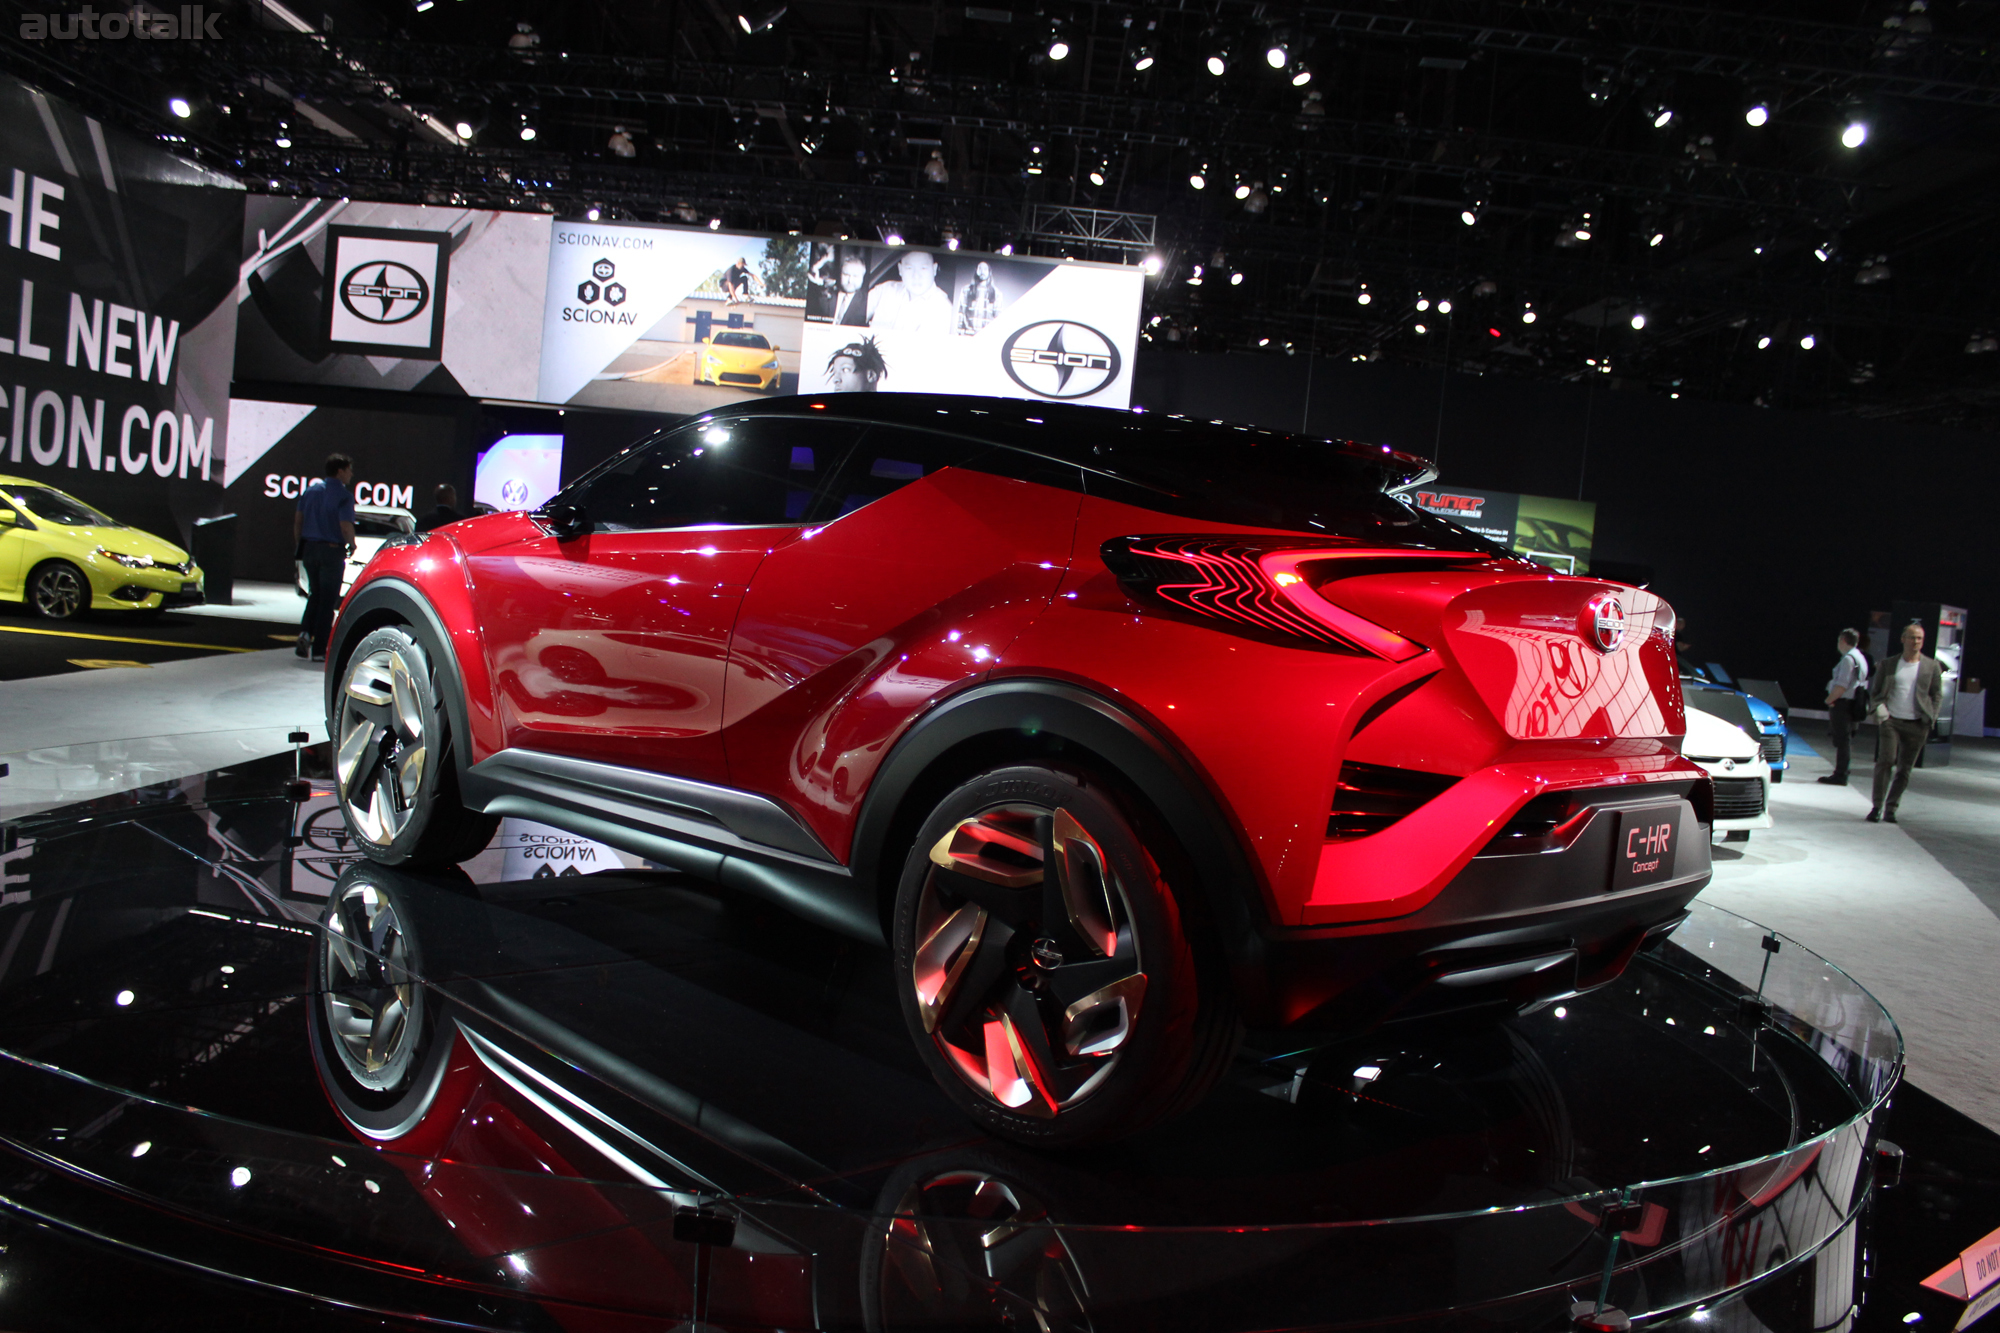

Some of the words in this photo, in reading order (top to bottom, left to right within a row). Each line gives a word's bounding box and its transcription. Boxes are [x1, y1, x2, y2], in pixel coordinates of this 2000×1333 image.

[558, 232, 654, 250] SCIONAV.COM
[347, 284, 422, 300] SCION
[562, 306, 615, 325] SCION
[66, 292, 180, 386] NEW
[1010, 348, 1111, 370] SCION
[264, 473, 414, 509] SCICOM
[1416, 491, 1485, 510] TUNER
[1627, 823, 1671, 858] C-HR
[1632, 858, 1660, 874] Concept
[1976, 1258, 1987, 1281] DO
[1986, 1249, 1999, 1274] NOT
